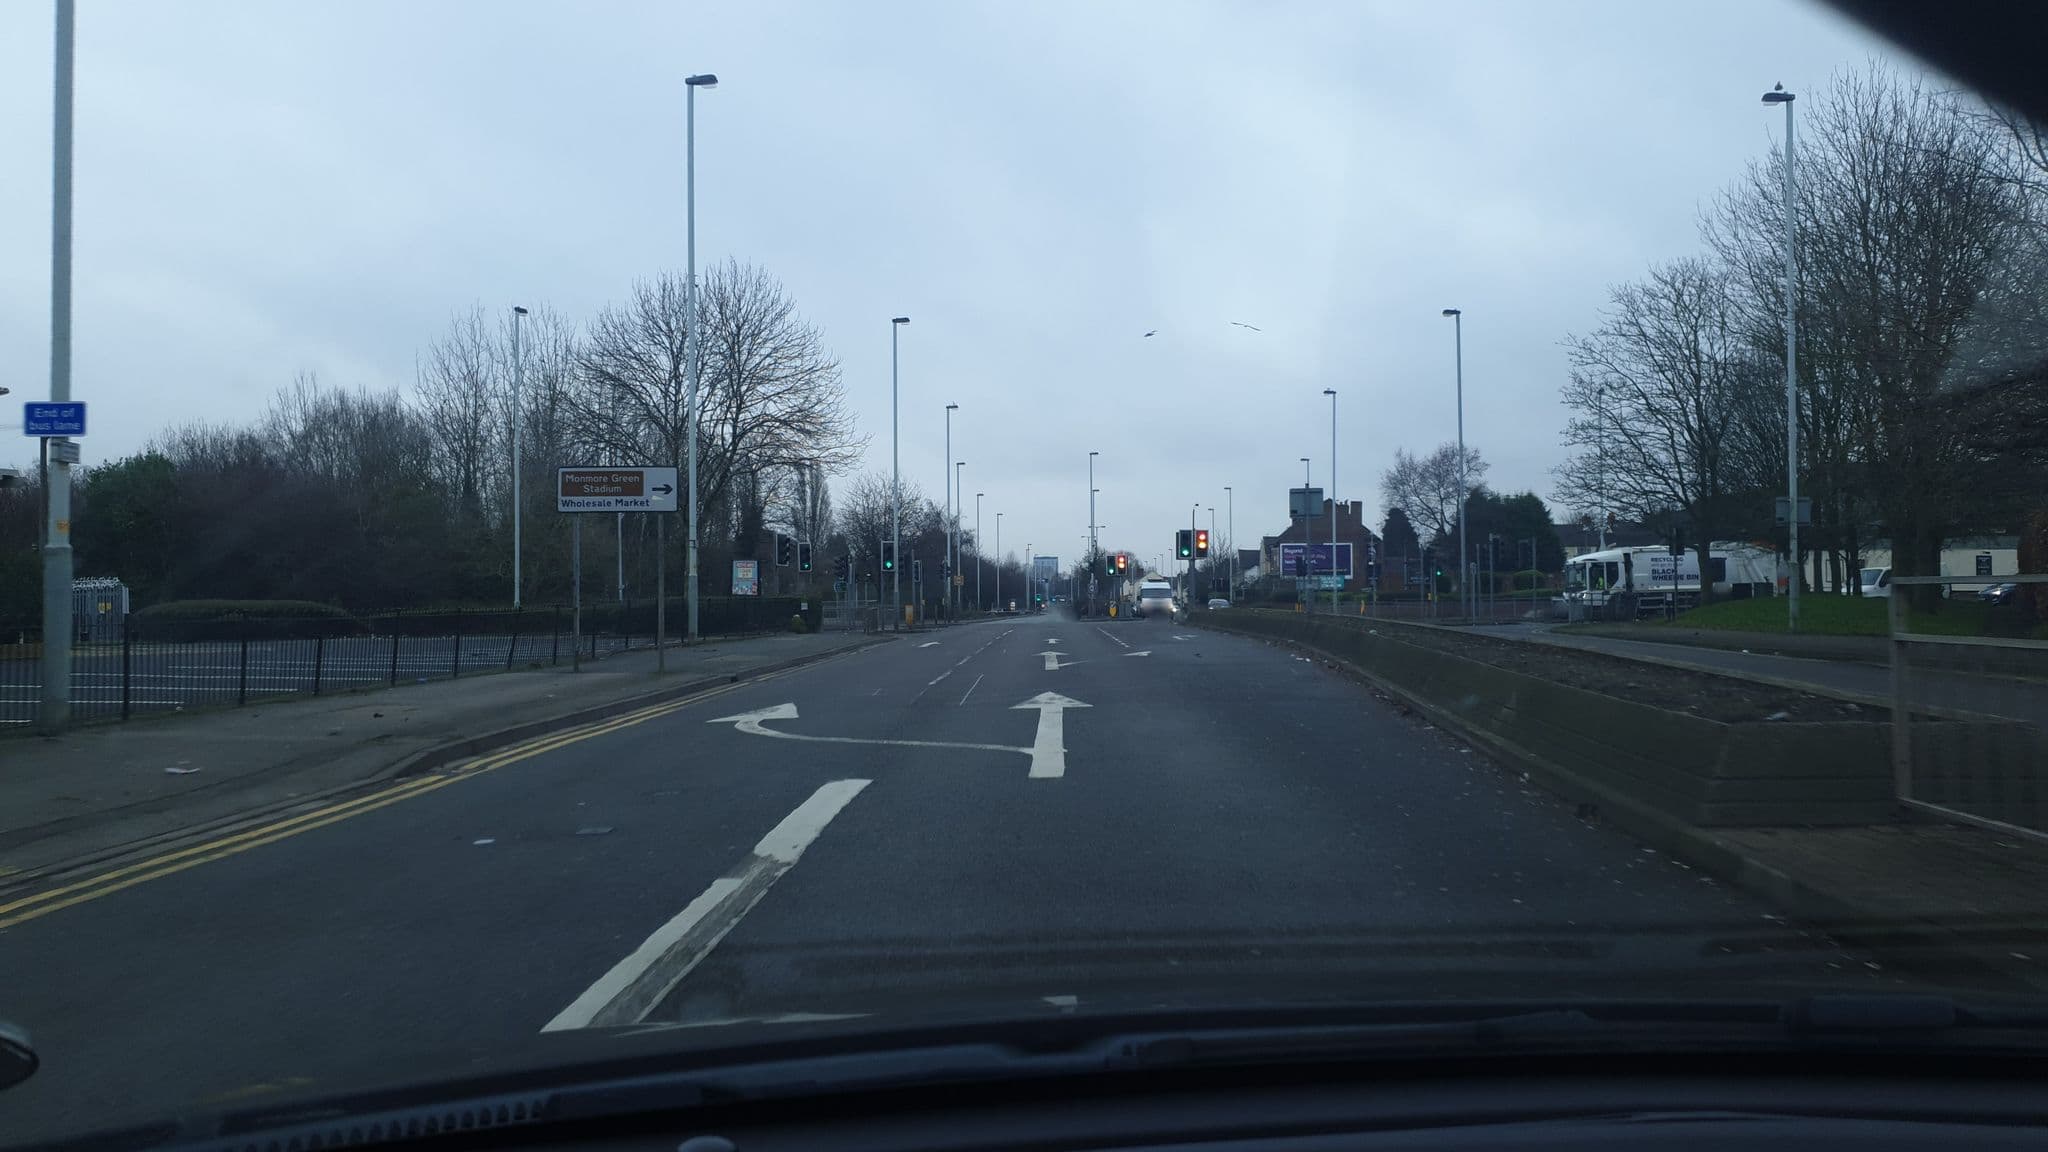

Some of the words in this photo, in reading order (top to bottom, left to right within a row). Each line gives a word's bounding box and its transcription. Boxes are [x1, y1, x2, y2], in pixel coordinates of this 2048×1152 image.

[34, 408, 58, 418] End
[565, 474, 609, 483] Monmore
[611, 474, 640, 483] Green
[583, 484, 622, 493] Stadium
[561, 499, 612, 508] Wholesale
[615, 499, 650, 508] Market
